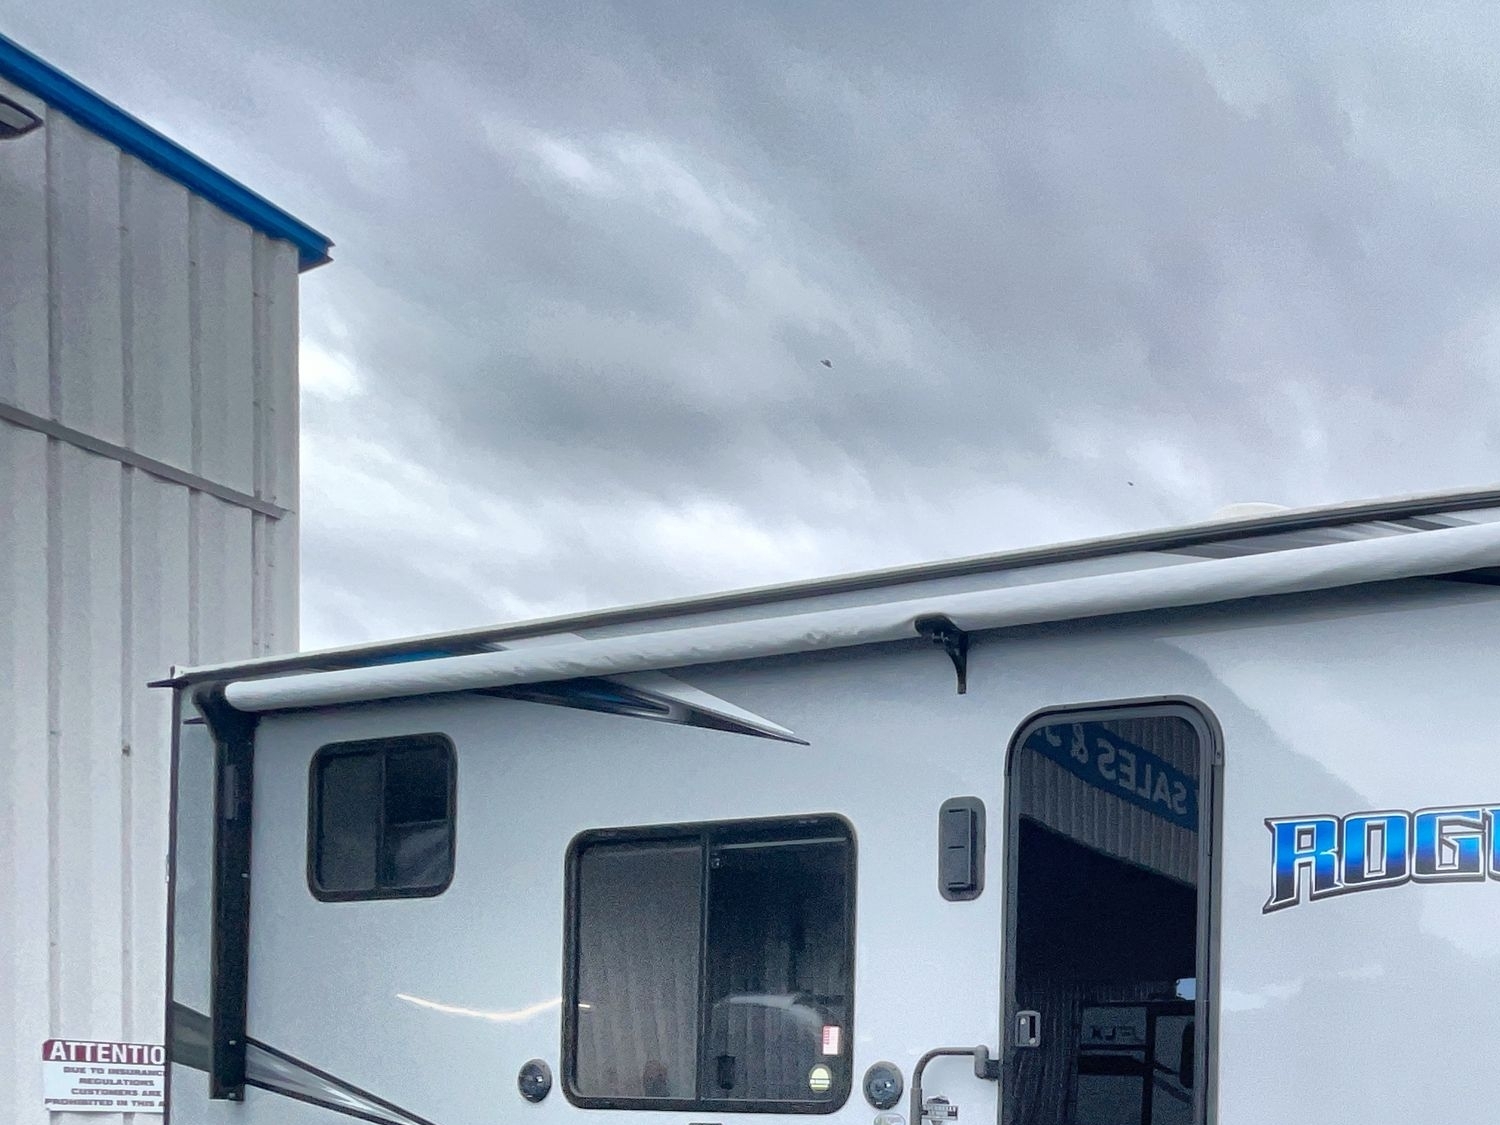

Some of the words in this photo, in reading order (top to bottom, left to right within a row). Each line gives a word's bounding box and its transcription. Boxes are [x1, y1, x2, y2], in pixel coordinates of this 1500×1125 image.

[49, 1041, 165, 1065] ATTENTIO
[63, 1066, 86, 1074] DUE
[91, 1067, 104, 1075] TO
[108, 1068, 165, 1076] INSURANC
[71, 1088, 138, 1096] CUSTOMERS
